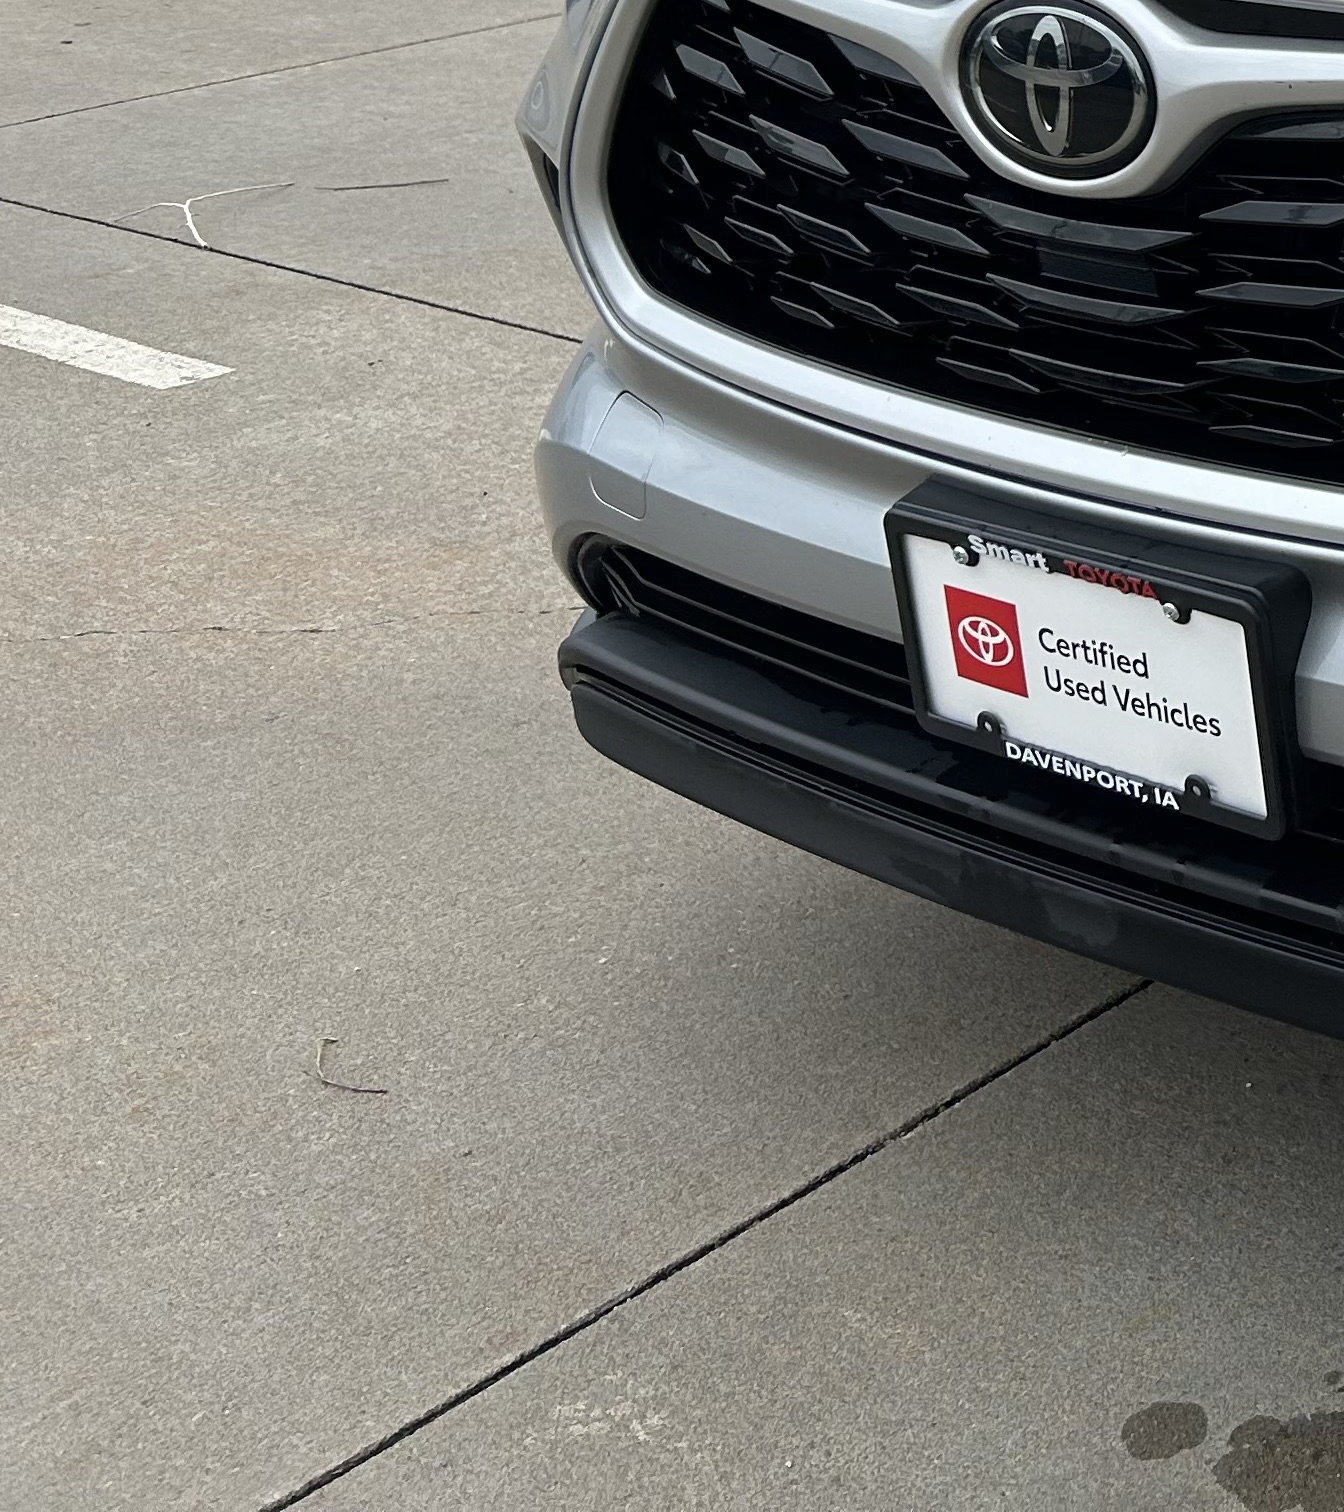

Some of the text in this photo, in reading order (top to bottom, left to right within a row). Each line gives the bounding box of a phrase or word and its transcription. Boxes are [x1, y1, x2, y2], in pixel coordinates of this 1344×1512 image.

[968, 534, 1160, 600] Smart TOYOTA
[1038, 628, 1150, 679] Certified
[1044, 666, 1222, 737] Used Vehicles
[1005, 741, 1180, 810] DAVENPORT, IA
